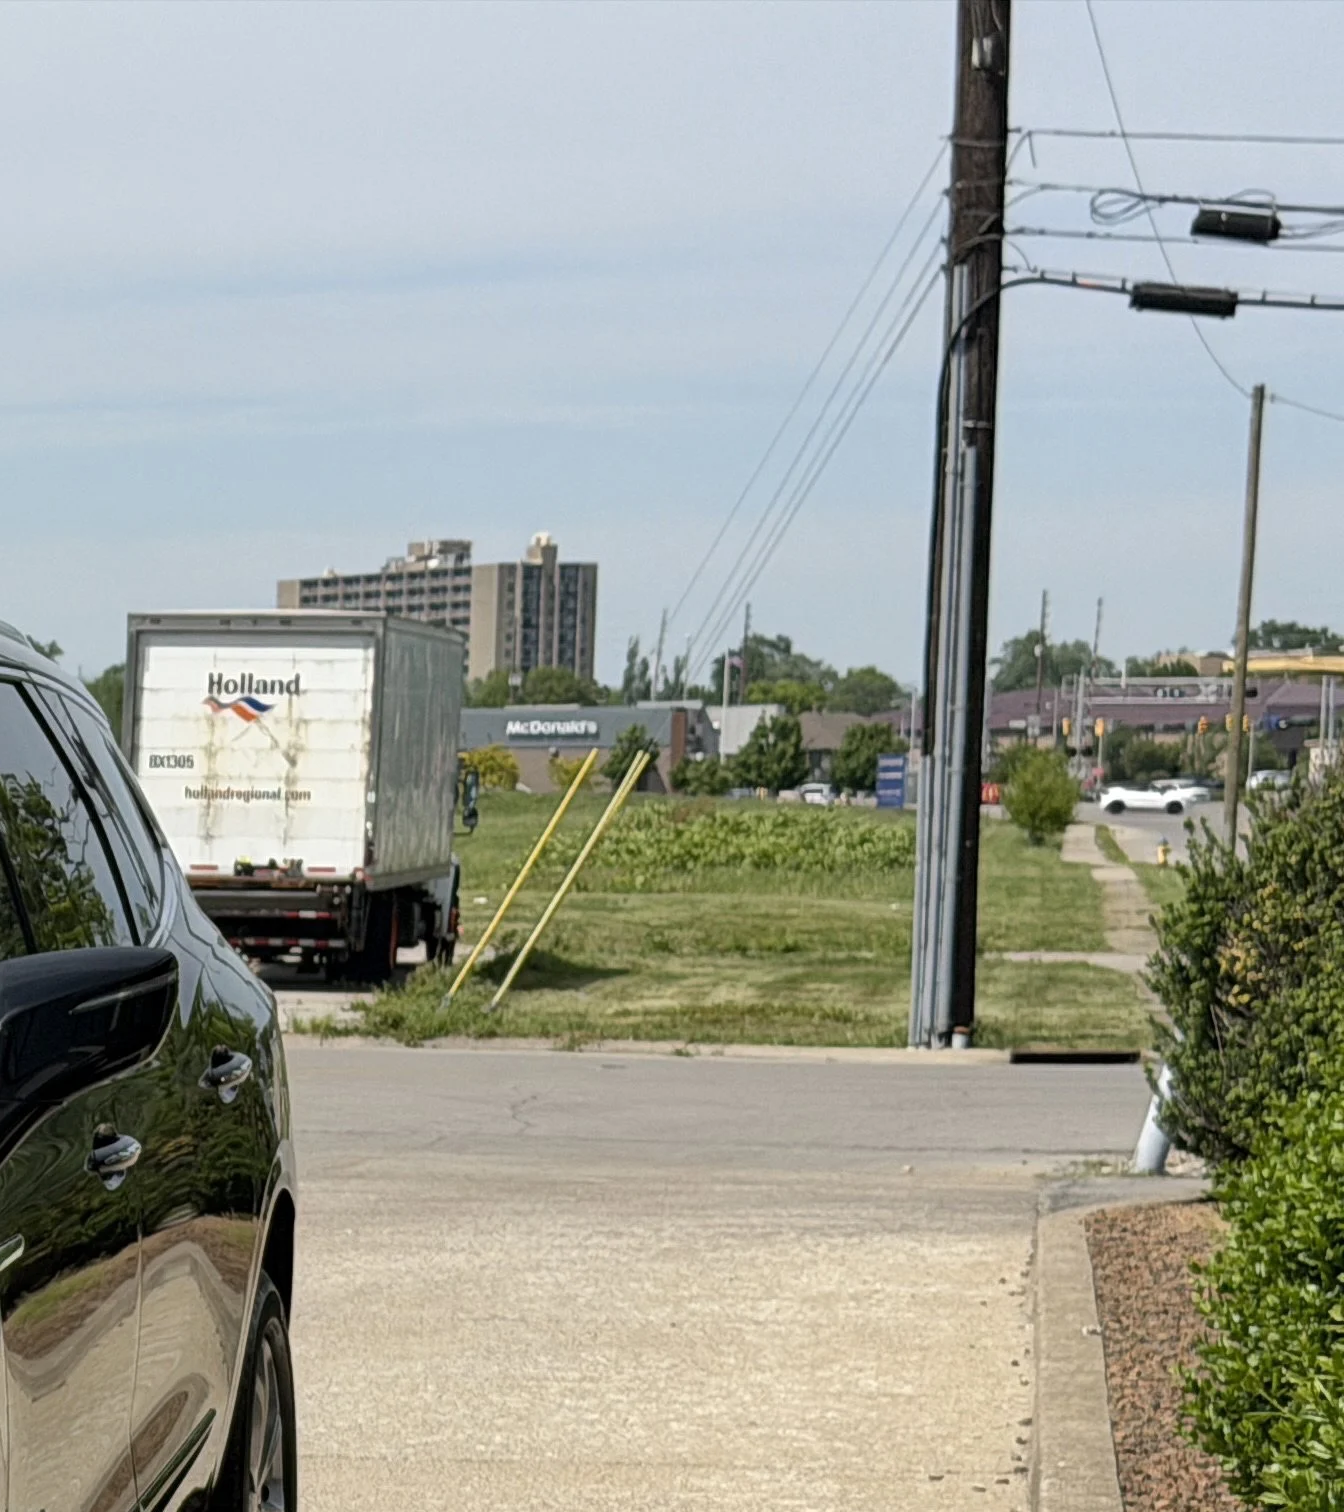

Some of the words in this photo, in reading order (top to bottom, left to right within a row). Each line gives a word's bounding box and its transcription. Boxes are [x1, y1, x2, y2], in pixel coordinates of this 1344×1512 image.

[208, 672, 301, 695] Holland
[506, 720, 598, 736] McDonald's
[184, 785, 312, 803] hollandregionalcom
